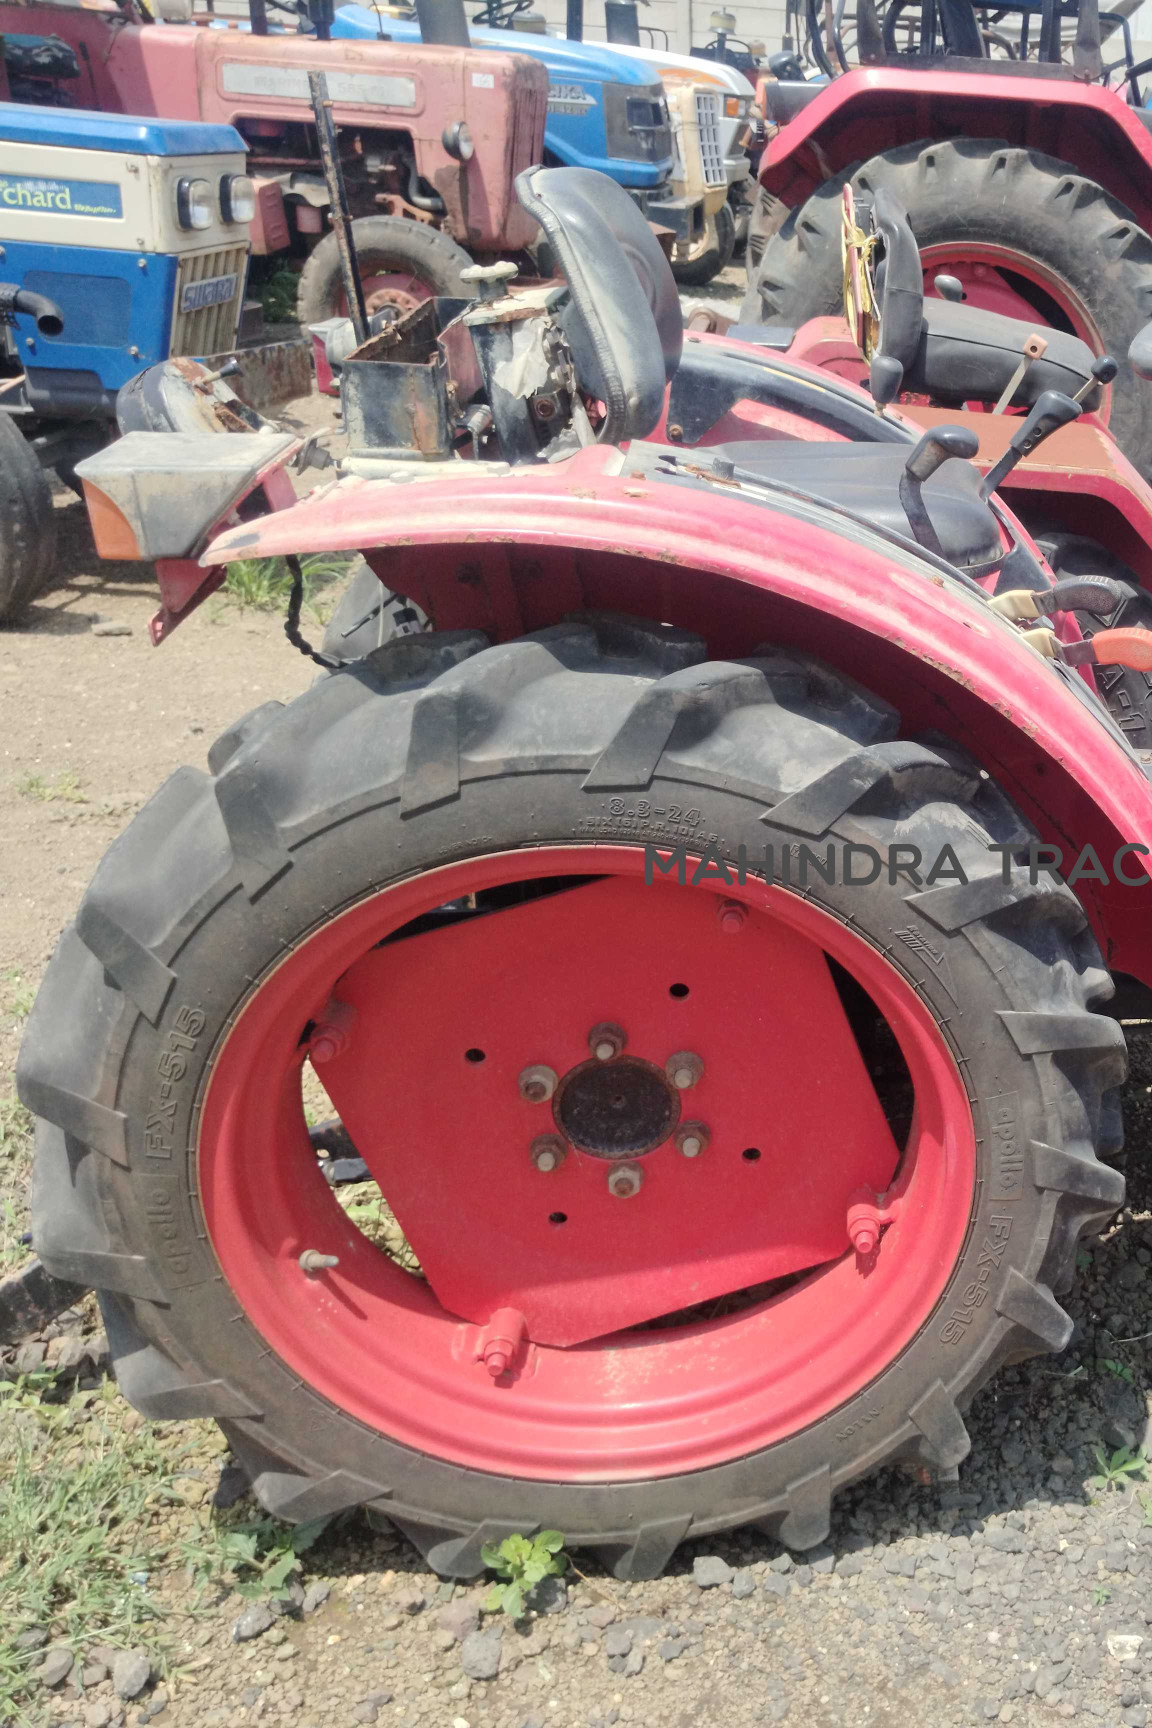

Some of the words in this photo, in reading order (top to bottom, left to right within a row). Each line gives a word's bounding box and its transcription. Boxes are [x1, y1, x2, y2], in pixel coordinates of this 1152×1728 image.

[0, 183, 72, 210] chard
[609, 797, 701, 827] 8.3-24
[145, 1004, 207, 1160] FX-515
[939, 1214, 1014, 1346] FX-515
